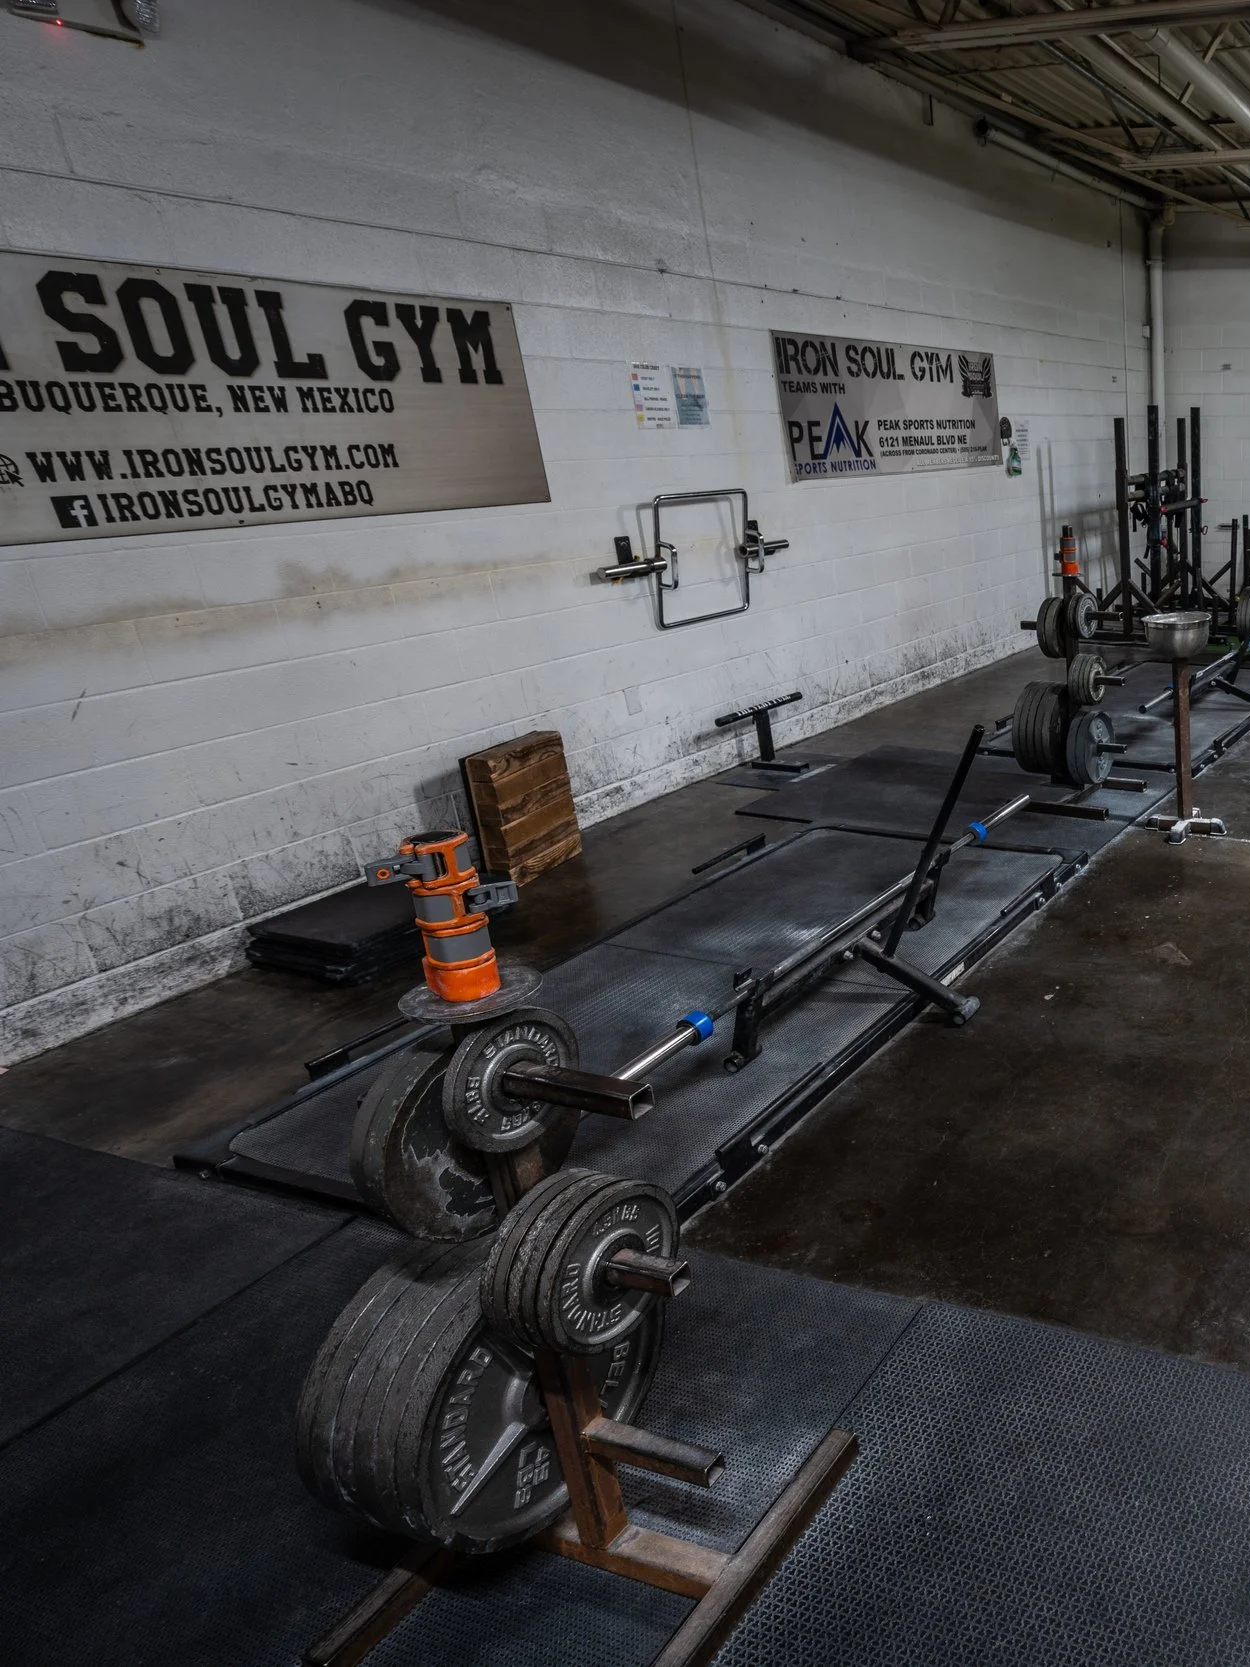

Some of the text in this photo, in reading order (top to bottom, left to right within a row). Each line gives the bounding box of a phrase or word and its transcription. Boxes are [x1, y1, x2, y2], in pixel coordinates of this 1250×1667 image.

[35, 269, 504, 385] SOUL GYM
[774, 337, 954, 383] IRON SOUL GYM
[227, 384, 290, 414] NEW
[297, 386, 395, 414] MEXICO
[781, 380, 846, 395] TEAMS WITH
[787, 401, 874, 461] PEAK
[877, 419, 976, 431] PEAK SPORTS NUTRITION
[879, 434, 967, 448] 6121 MENAUL BLVD NE
[25, 442, 400, 484] WWW.IRONSOULGYM.COM
[794, 459, 876, 475] SPORTS NUTRITION
[97, 479, 375, 524] IRONSOULGYMABQ
[439, 1345, 494, 1493] STANDARD
